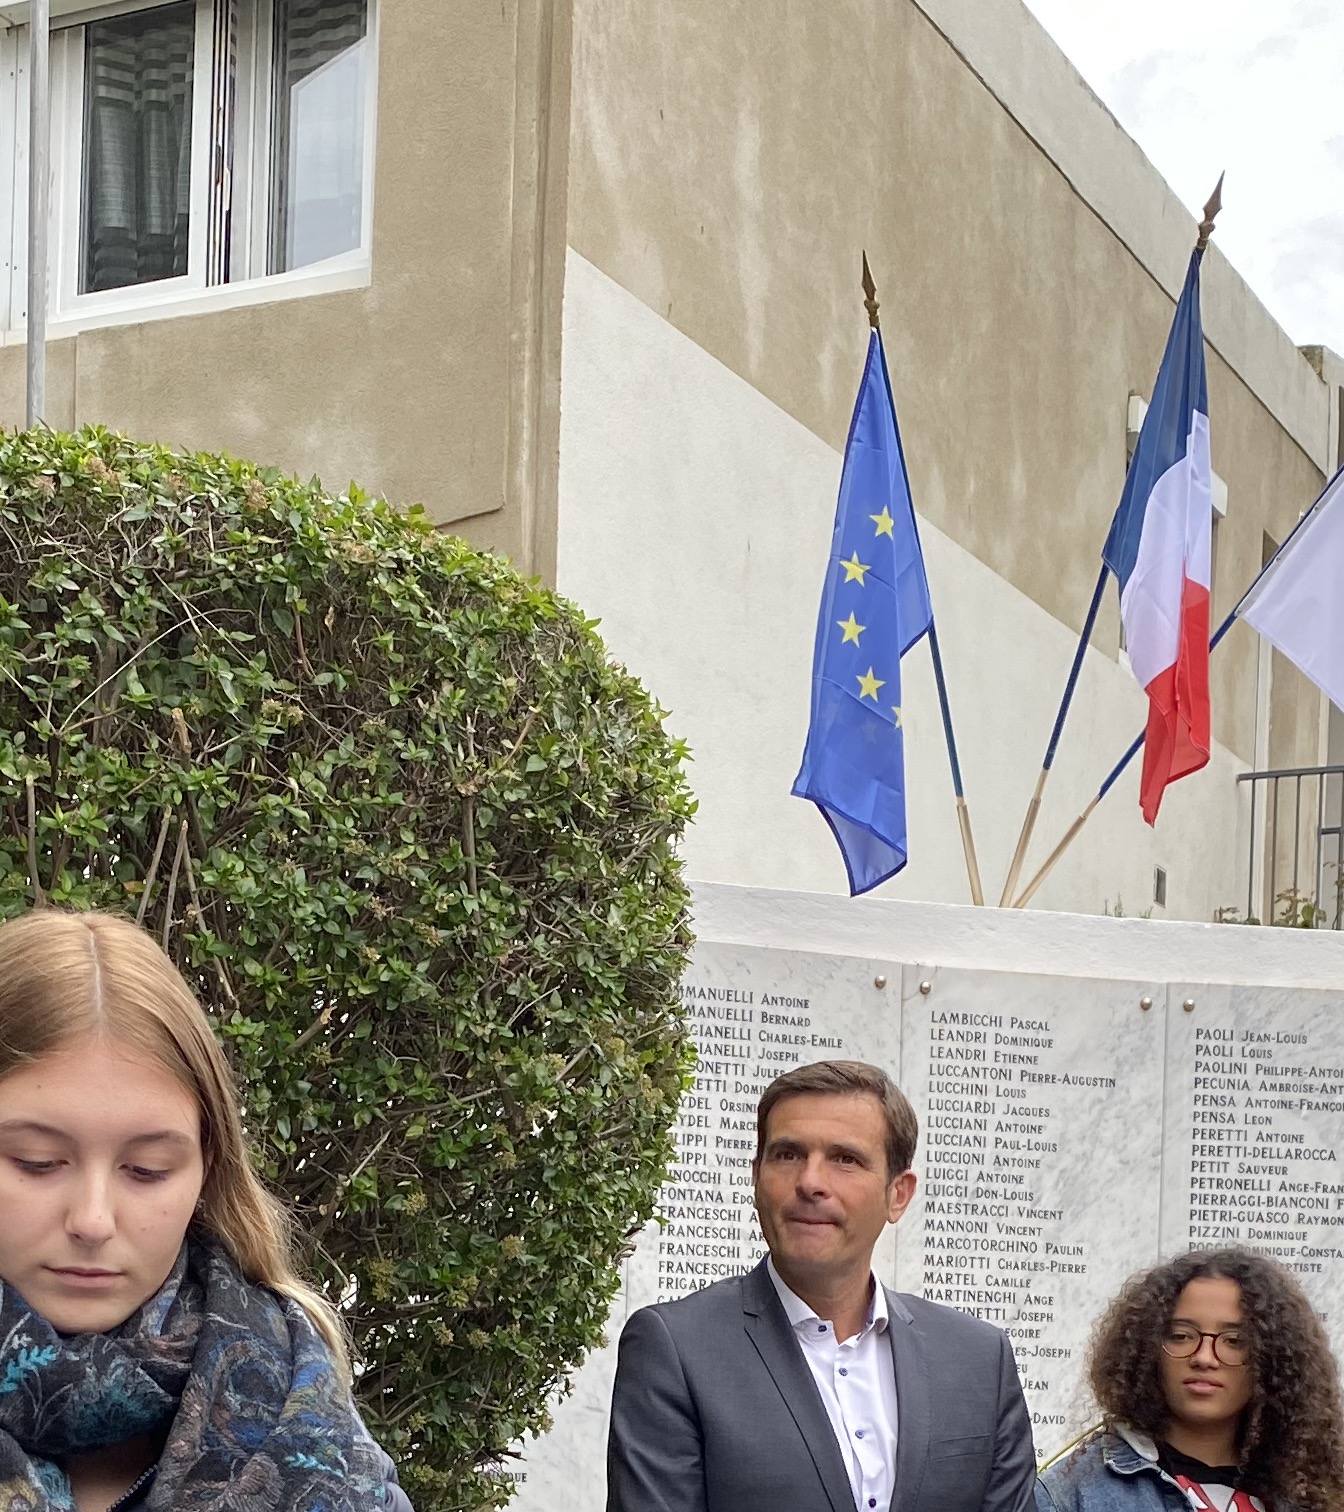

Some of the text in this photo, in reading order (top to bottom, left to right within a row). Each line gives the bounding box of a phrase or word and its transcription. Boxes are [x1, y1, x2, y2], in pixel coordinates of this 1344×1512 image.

[931, 1011, 1002, 1028] LAMBICCHI
[931, 1028, 986, 1044] LEANDRI
[1196, 1029, 1233, 1041] PAOLI
[930, 1046, 986, 1061] LEANDRI
[1195, 1045, 1233, 1057] PAOLI
[929, 1064, 1012, 1081] LUCCANTONI
[1194, 1061, 1247, 1075] PAOLINI
[929, 1081, 988, 1096] LUCCHINI
[1194, 1077, 1250, 1091] PECUNIA
[928, 1099, 995, 1115] LUCCIARDI
[1193, 1095, 1236, 1107] PENSA
[927, 1116, 987, 1131] LUCCIANI
[1193, 1112, 1235, 1124] PENSA
[927, 1133, 986, 1148] LUCCIANI
[1192, 1128, 1247, 1142] PERETTI
[926, 1150, 985, 1165] LUCCIONI
[1192, 1144, 1336, 1161] PERETTI-DELLAROCCA
[926, 1167, 968, 1181] LUIGGI
[1191, 1161, 1229, 1173] PETIT
[925, 1184, 968, 1198] LUIGGI
[1190, 1177, 1270, 1192] PETRONELLI
[660, 1188, 724, 1203] FONTANA
[1190, 1193, 1329, 1209] PIERRAGGI-BIANCONI
[925, 1202, 1008, 1217] MAESTRACCI
[1189, 1210, 1289, 1224] PIETRI-GUASCO
[924, 1219, 988, 1234] MANNONI
[1189, 1226, 1239, 1238] PIZZINI
[659, 1243, 740, 1258] FRANCESCHI
[924, 1237, 1037, 1254] MARCOTORCHINO
[924, 1255, 990, 1269] MARIOTTI
[923, 1272, 977, 1286] MARTEL
[923, 1288, 1016, 1304] MARTINENGHI
